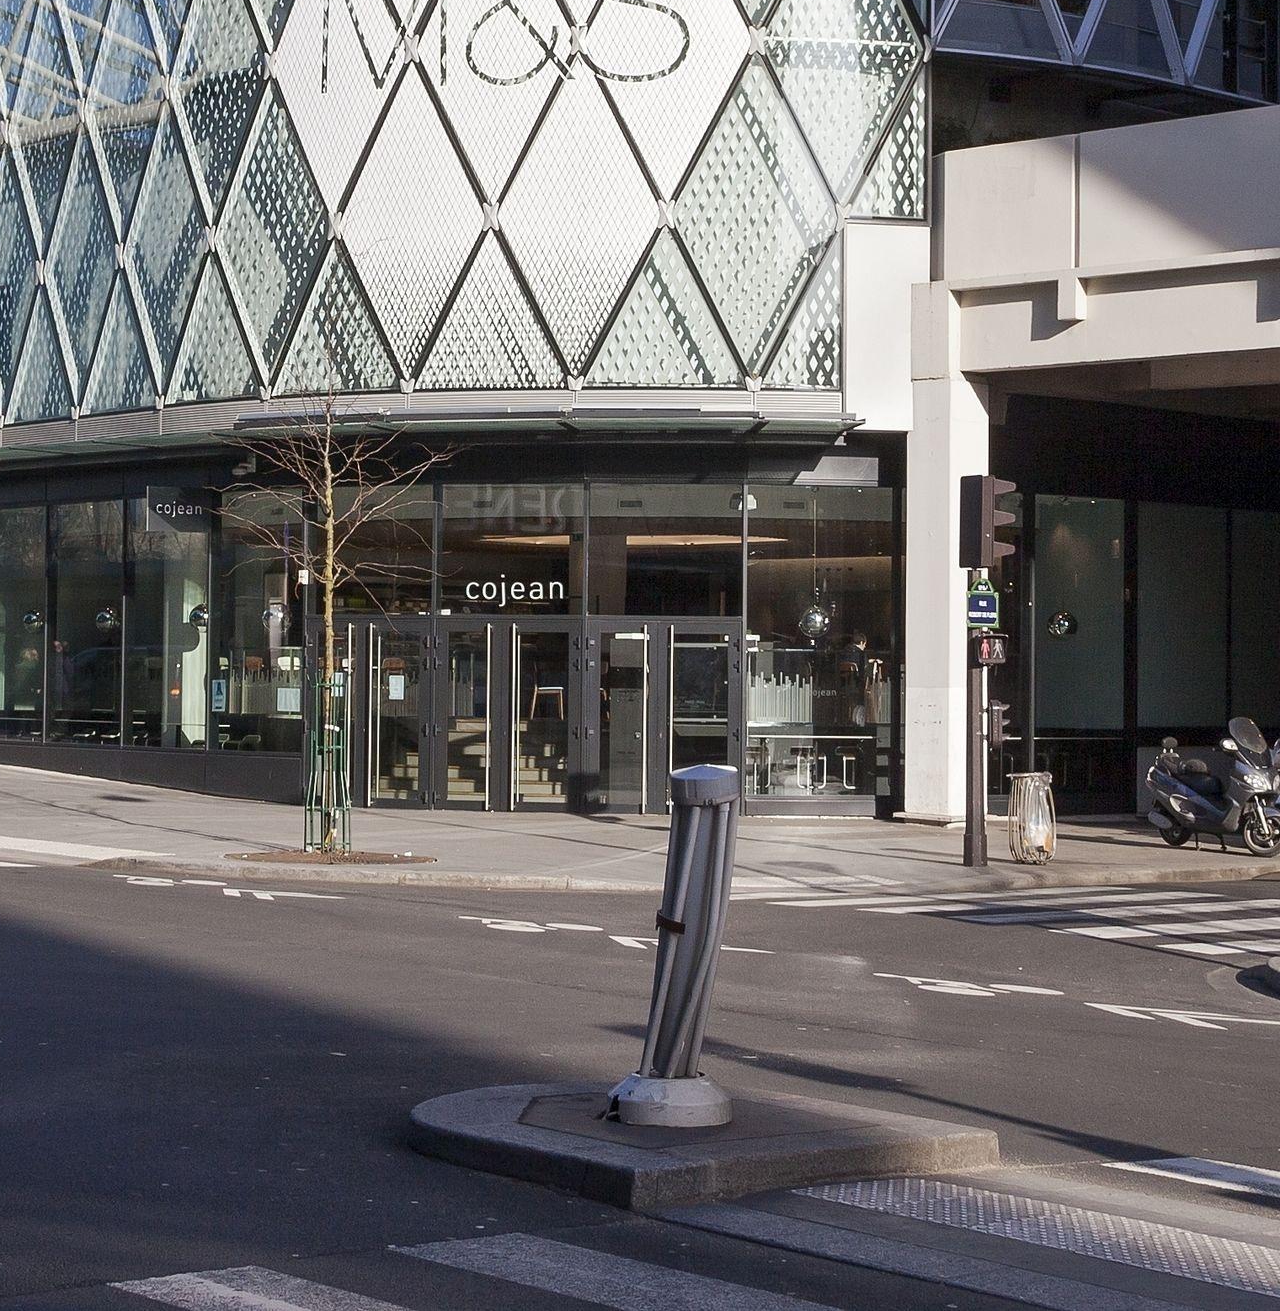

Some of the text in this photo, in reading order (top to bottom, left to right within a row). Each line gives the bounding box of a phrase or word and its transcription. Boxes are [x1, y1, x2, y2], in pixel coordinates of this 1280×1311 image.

[156, 500, 203, 518] cojean
[465, 573, 564, 607] cojean
[810, 689, 837, 698] ojean
